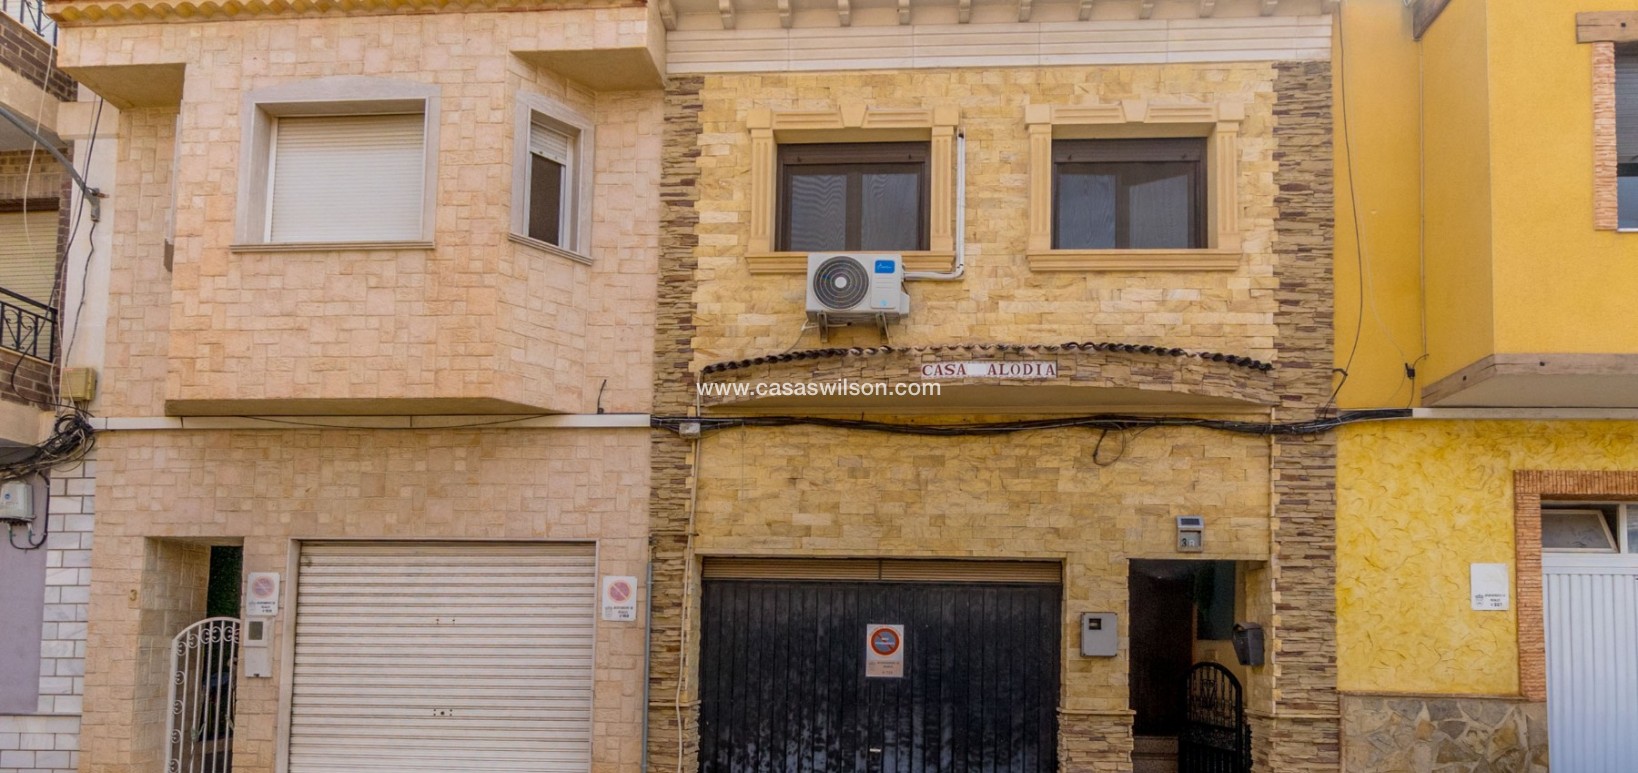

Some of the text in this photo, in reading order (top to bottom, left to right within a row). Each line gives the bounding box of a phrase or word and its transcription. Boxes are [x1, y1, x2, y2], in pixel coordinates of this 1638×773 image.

[922, 363, 1056, 376] CASA ALODIA
[129, 589, 137, 601] 3
